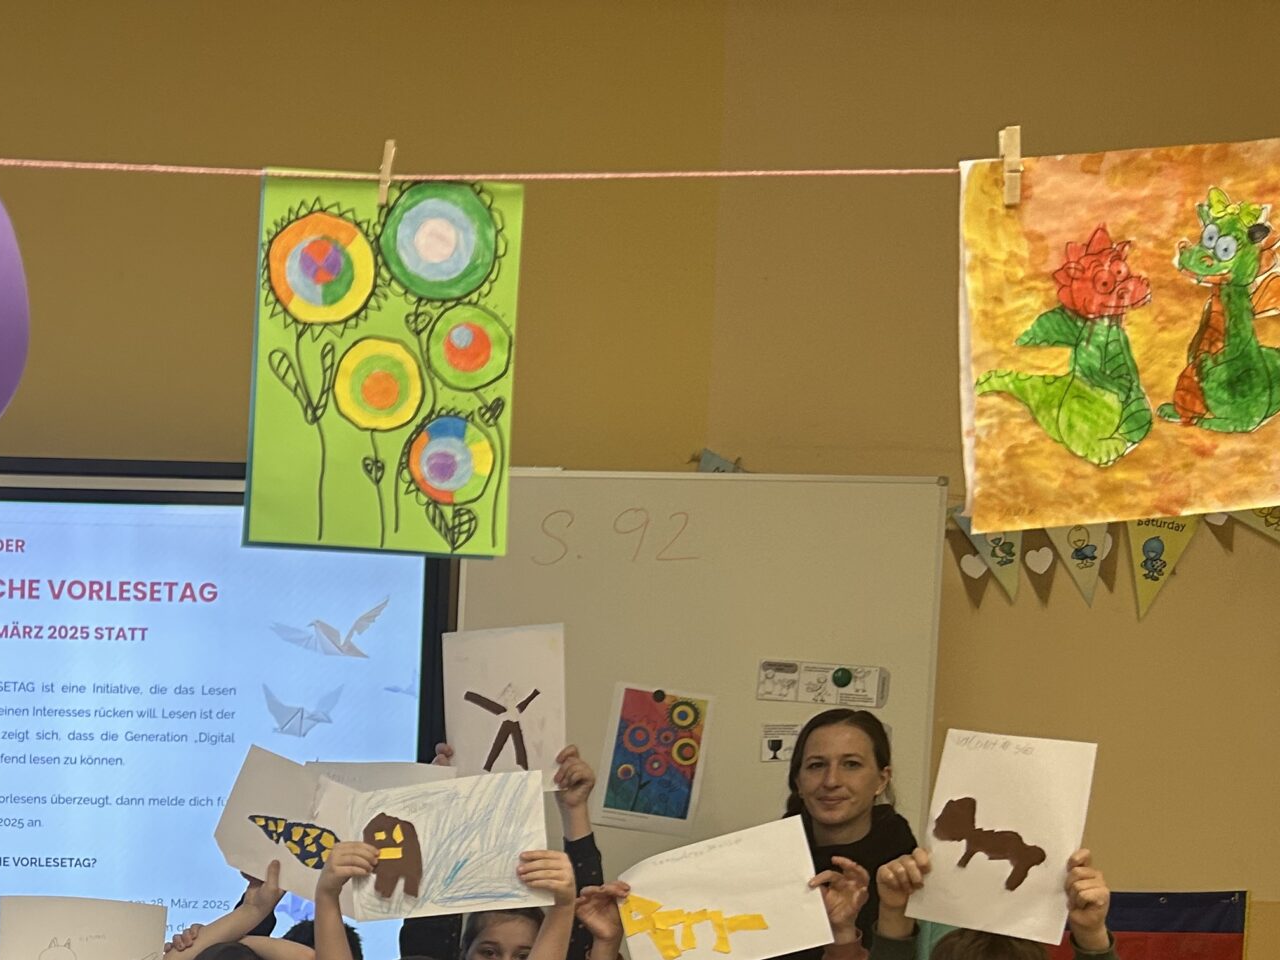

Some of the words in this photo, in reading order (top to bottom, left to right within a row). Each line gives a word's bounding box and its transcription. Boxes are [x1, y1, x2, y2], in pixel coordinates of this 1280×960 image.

[613, 506, 700, 563] 92
[48, 579, 218, 603] VORLESETAG
[47, 625, 91, 641] 2025
[94, 626, 149, 643] STATT
[41, 682, 56, 693] ist
[61, 683, 87, 694] eine
[92, 682, 144, 696] Initiative,
[149, 684, 169, 695] die
[173, 684, 196, 696] das
[201, 685, 237, 696] Lesen
[32, 706, 92, 718] Interesses
[94, 706, 134, 719] rücken
[161, 708, 197, 720] Lesen
[200, 709, 214, 720] ist
[216, 709, 236, 720] der
[1, 729, 30, 743] zeigt
[67, 730, 95, 742] dass
[100, 730, 120, 742] die
[124, 731, 189, 743] Generation
[29, 754, 61, 766] lesen
[63, 756, 78, 766] zu
[115, 795, 145, 807] dann
[148, 795, 186, 807] melde
[188, 796, 214, 808] dich
[12, 856, 98, 870] VORLESETAG?
[170, 897, 199, 910] März
[202, 900, 231, 912] 2025
